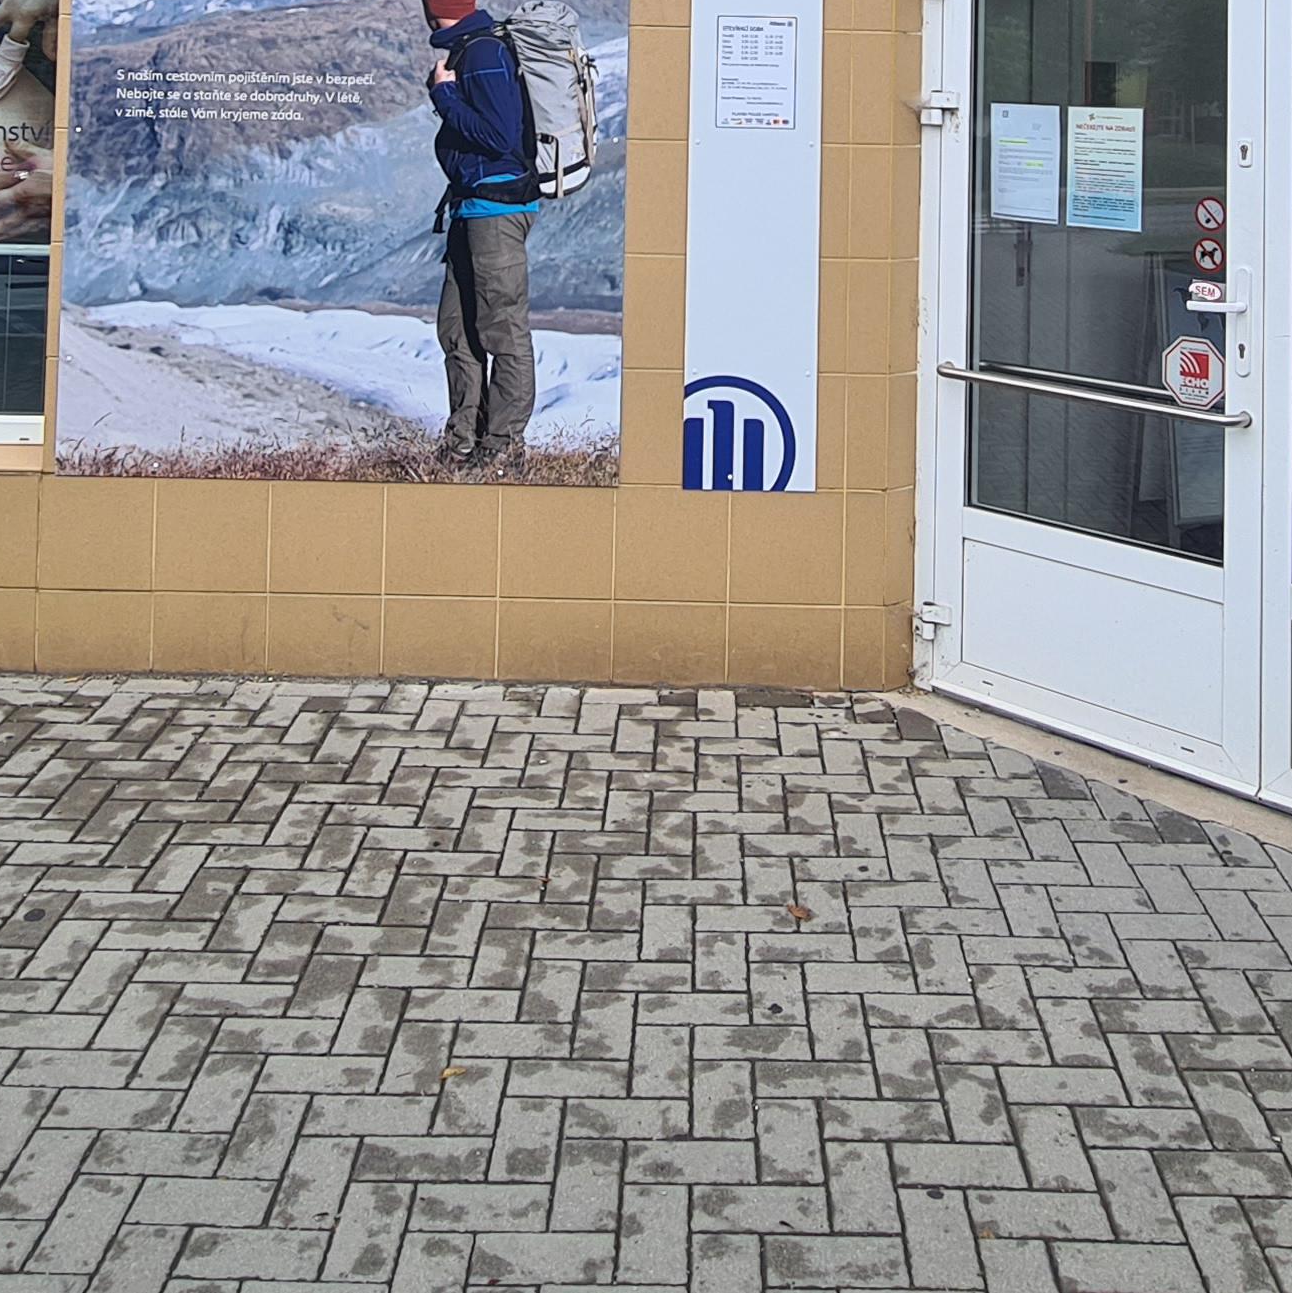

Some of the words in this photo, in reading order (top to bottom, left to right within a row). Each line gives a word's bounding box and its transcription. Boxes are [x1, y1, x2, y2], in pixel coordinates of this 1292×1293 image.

[116, 69, 125, 81] S
[127, 69, 163, 82] naším
[166, 71, 226, 83] cestovním
[228, 71, 290, 86] pojištěním
[292, 72, 314, 86] jste
[316, 75, 324, 84] v
[325, 73, 376, 87] bezpečí.
[116, 88, 164, 102] Nebojte
[166, 90, 180, 100] se
[182, 91, 191, 100] a
[193, 88, 232, 101] staňte
[234, 91, 248, 101] se
[249, 90, 322, 105] dobrodruhy.
[325, 92, 336, 102] V
[337, 91, 363, 105] létě,
[115, 109, 122, 117] v
[124, 106, 156, 120] zimě,
[158, 107, 188, 119] stále
[191, 107, 218, 119] Vám
[220, 108, 269, 122] kryjeme
[270, 109, 305, 121] záda.
[1195, 285, 1216, 298] SEM
